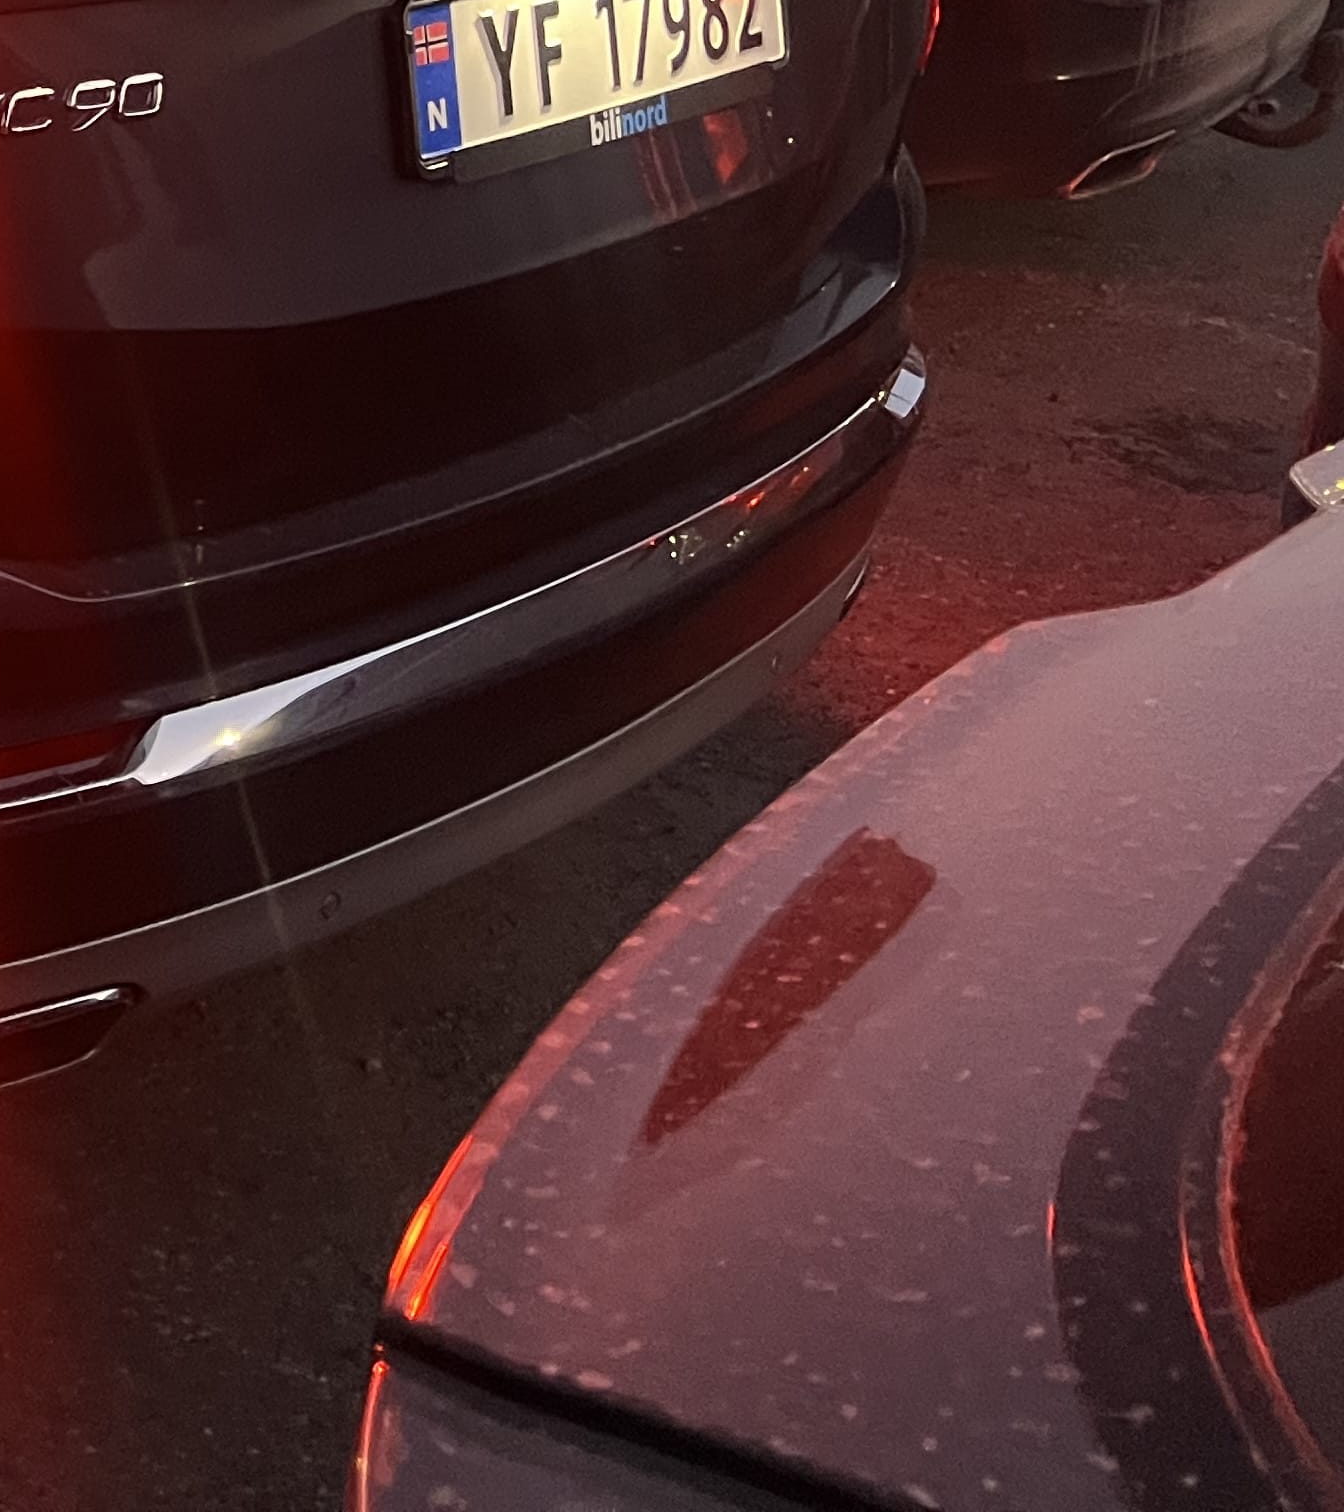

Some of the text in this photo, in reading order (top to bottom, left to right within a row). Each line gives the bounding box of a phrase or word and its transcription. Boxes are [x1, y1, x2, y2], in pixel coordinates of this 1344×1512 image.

[477, 0, 562, 118] YF
[426, 97, 448, 132] N
[590, 95, 669, 147] bilinord
